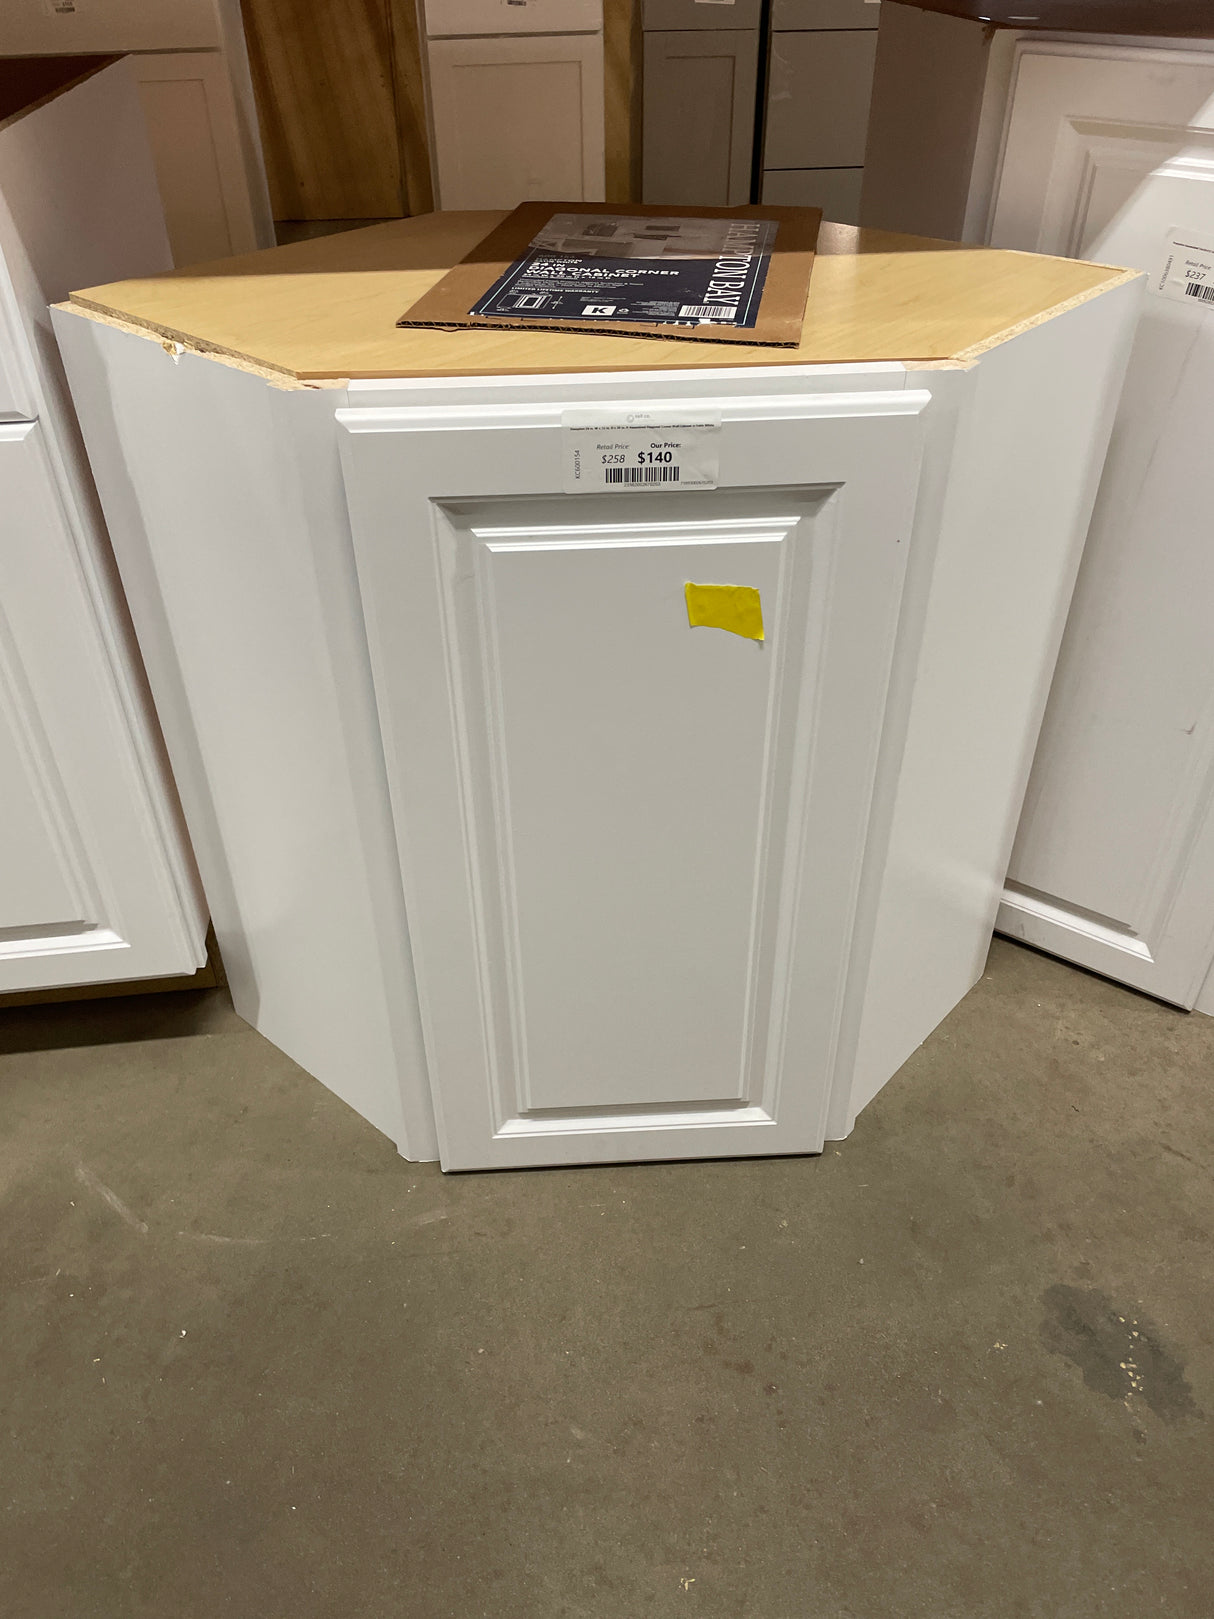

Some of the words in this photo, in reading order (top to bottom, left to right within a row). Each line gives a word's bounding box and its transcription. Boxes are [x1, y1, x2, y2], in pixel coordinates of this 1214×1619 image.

[712, 223, 760, 279] HAMPTON
[528, 265, 610, 273] DIAGONAL
[615, 268, 680, 276] CORNER
[1185, 270, 1206, 280] $237
[703, 280, 745, 305] BAY
[591, 307, 607, 315] K
[601, 454, 626, 464] $258
[637, 451, 673, 465] $140
